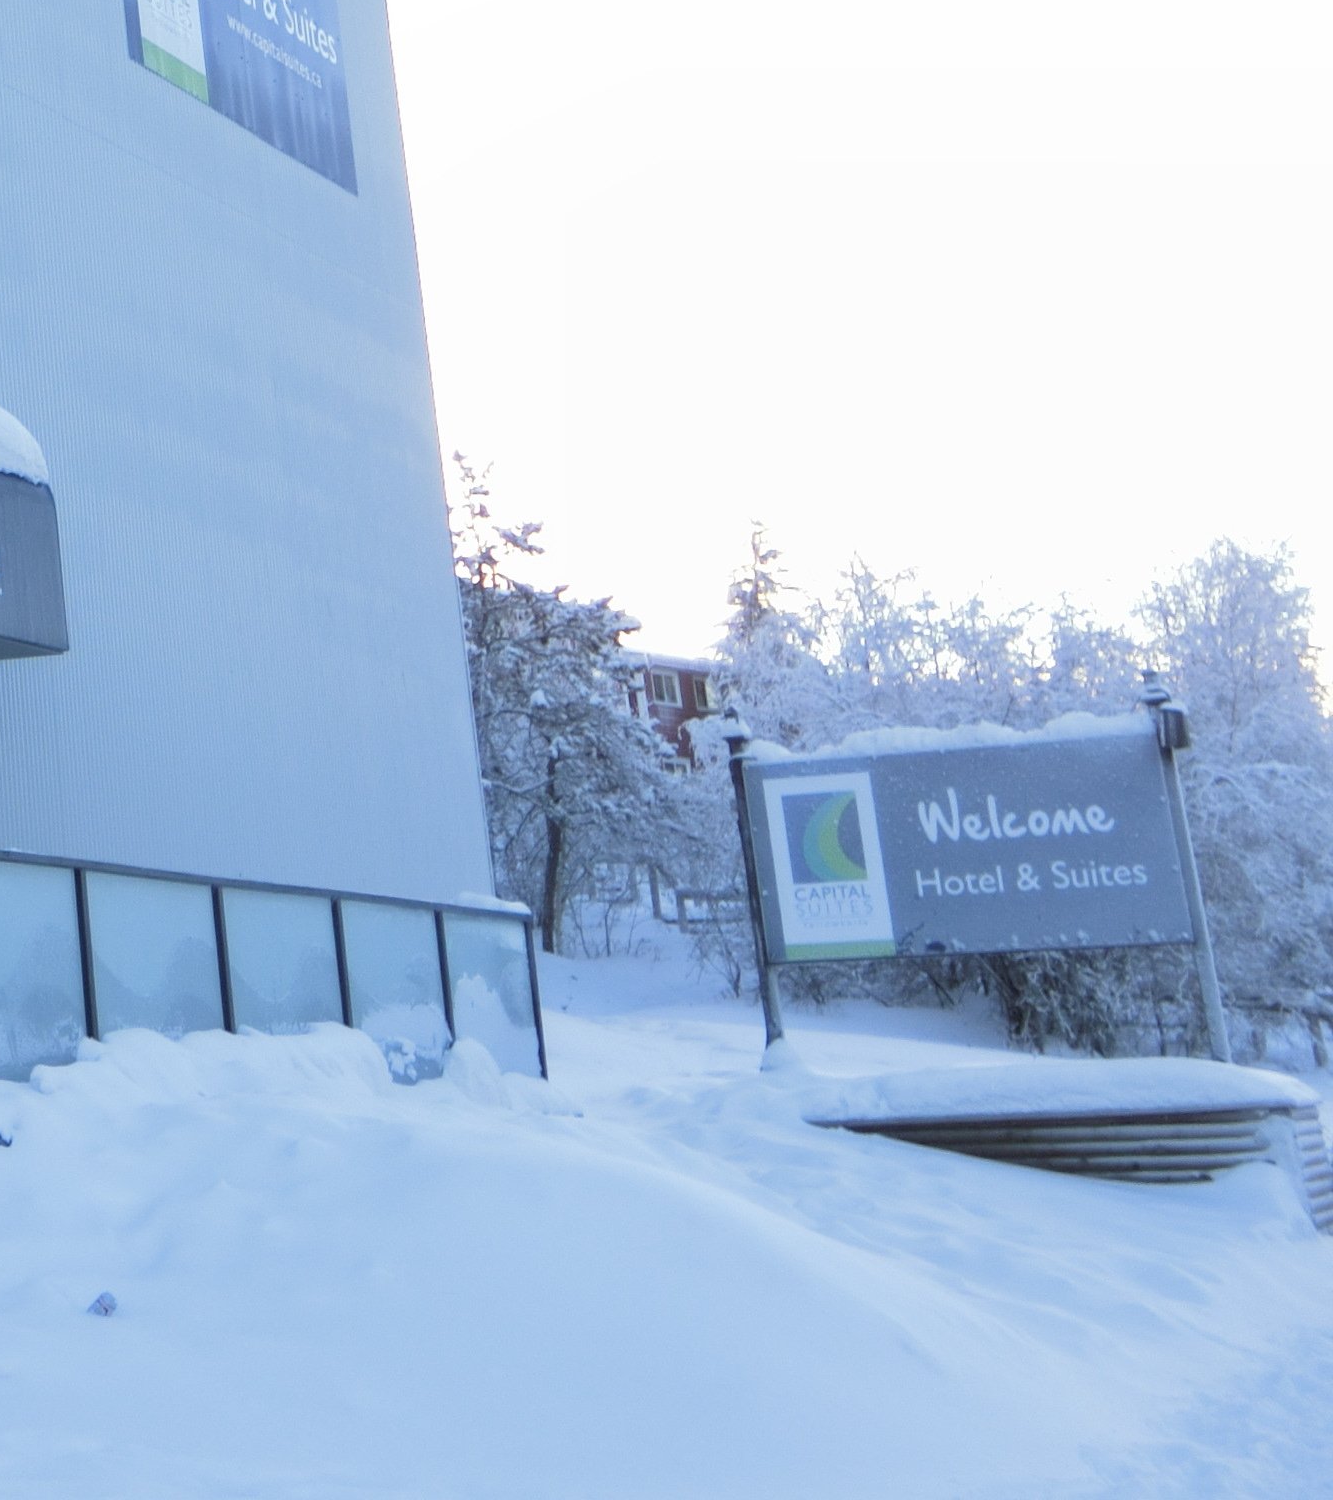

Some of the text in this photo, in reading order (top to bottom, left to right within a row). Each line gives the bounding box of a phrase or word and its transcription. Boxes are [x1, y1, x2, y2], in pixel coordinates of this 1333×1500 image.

[226, 12, 323, 89] www.capitalsuites.ca
[917, 787, 1116, 844] Welcome
[794, 884, 871, 901] CAPITAL
[915, 860, 1149, 898] Hotel & Suites
[796, 900, 874, 918] SUITES
